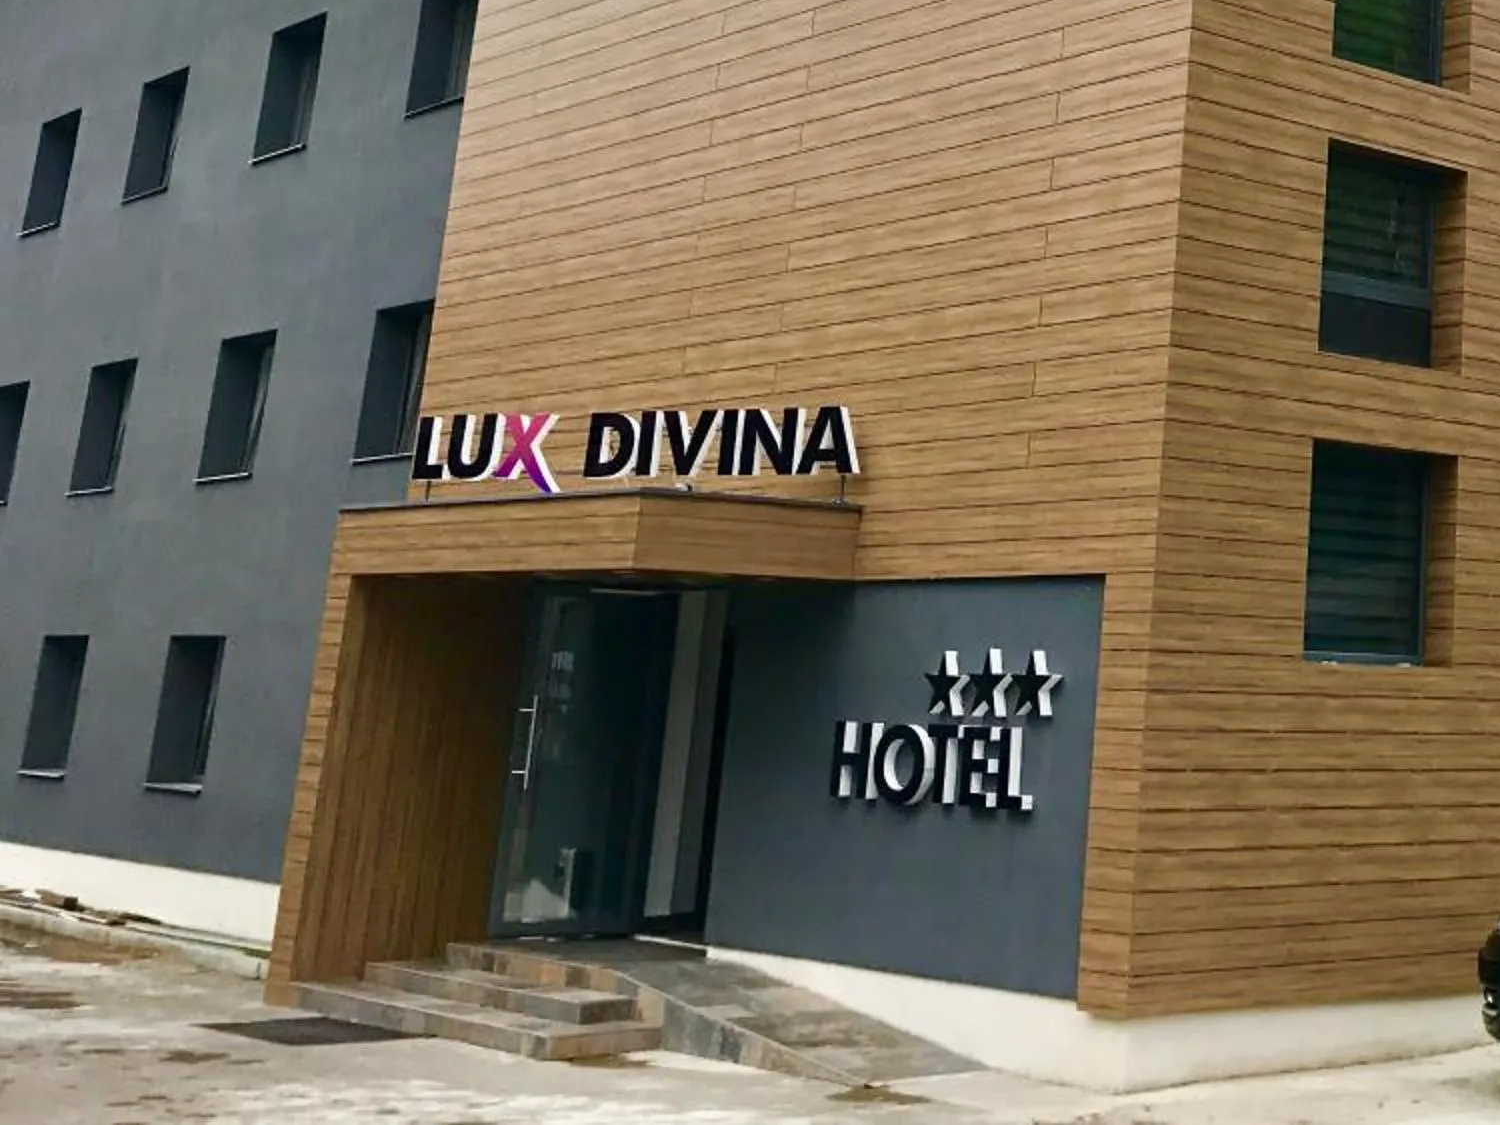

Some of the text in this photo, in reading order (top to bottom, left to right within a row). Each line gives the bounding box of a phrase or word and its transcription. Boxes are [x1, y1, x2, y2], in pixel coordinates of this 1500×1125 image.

[411, 406, 861, 493] LUX DIVINA
[830, 720, 1034, 811] HOTEL
